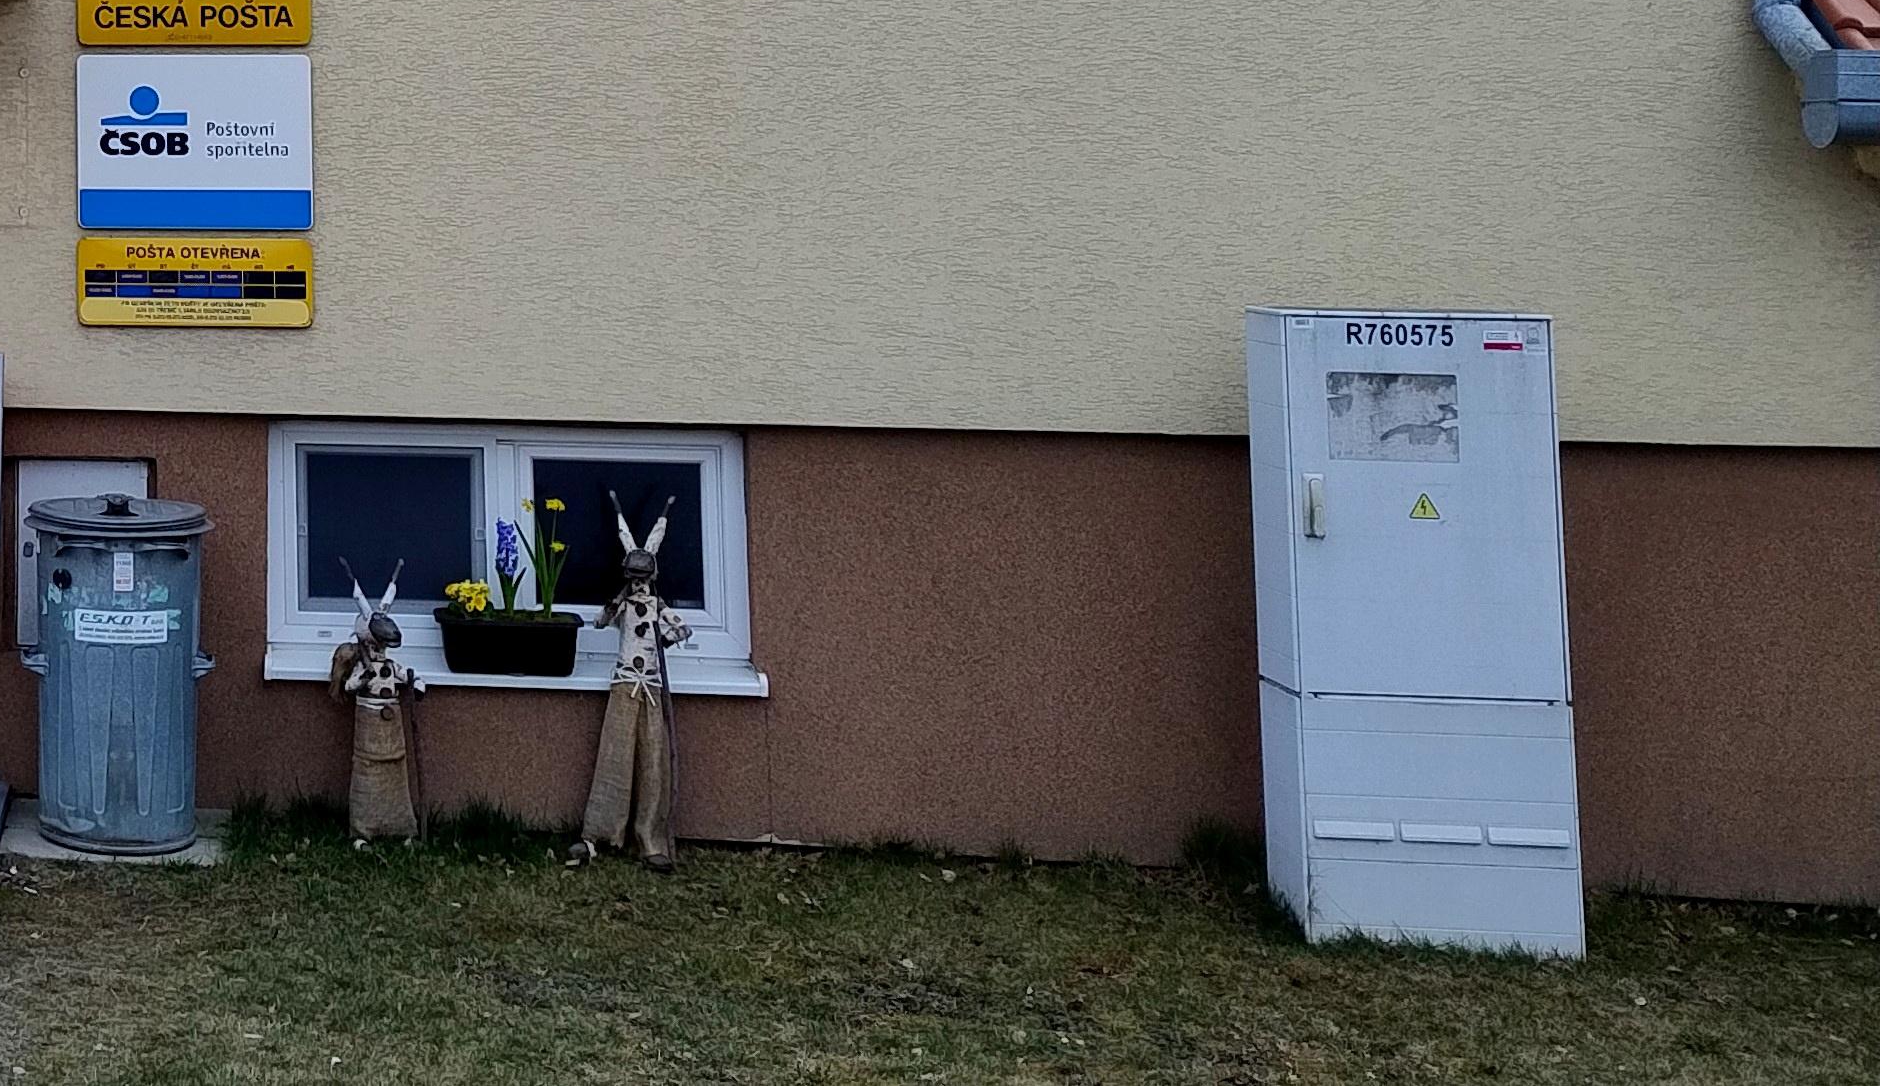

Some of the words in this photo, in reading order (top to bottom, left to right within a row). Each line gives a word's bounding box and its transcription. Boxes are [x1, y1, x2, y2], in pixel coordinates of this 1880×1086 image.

[94, 0, 188, 29] ČESKÁ
[200, 0, 293, 29] POŠTA
[206, 122, 275, 136] Poštovní
[99, 128, 190, 156] ČSOB
[206, 142, 289, 159] spořitelna
[126, 244, 176, 259] POŠTA
[1346, 322, 1455, 347] R760575
